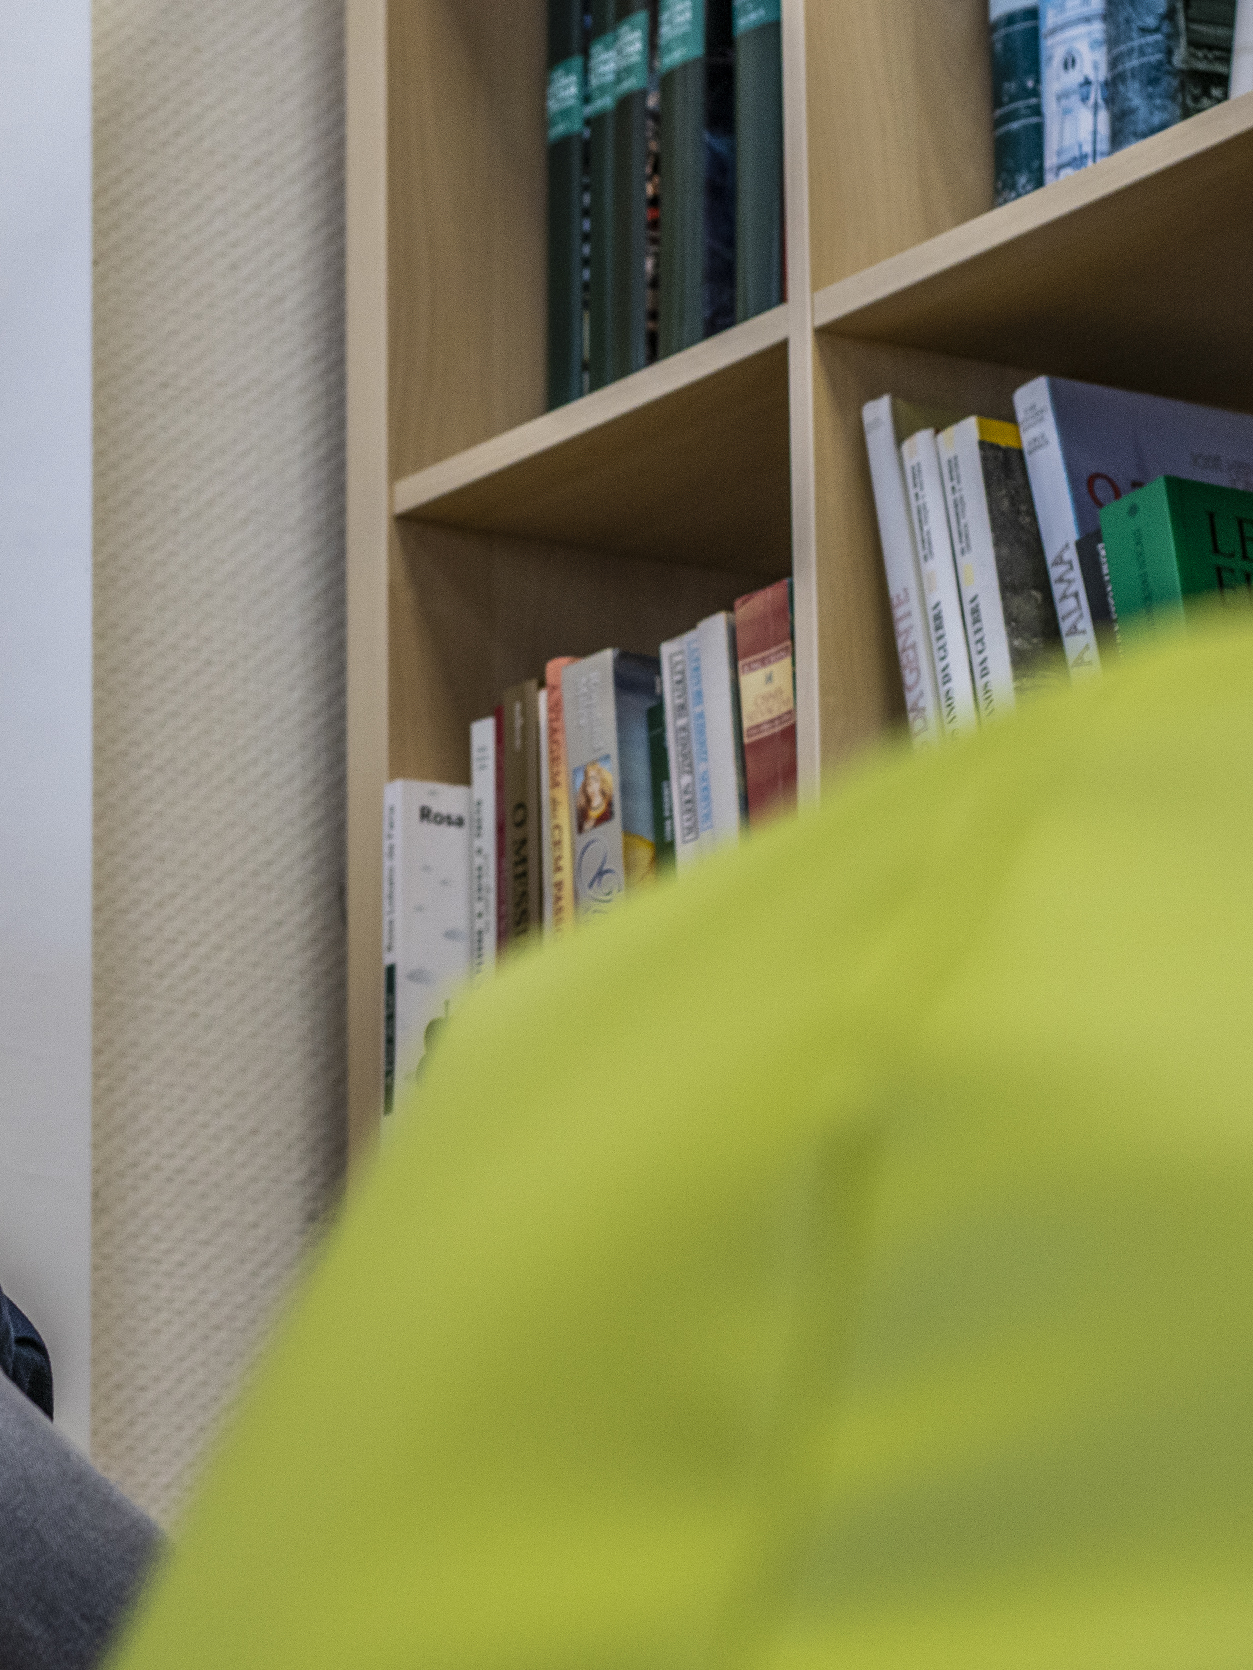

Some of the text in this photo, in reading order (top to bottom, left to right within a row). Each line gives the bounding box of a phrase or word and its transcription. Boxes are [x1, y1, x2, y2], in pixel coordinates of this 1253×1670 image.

[1047, 542, 1086, 638] ALMA
[889, 586, 922, 694] GENTE
[930, 599, 949, 662] GUERRA
[968, 593, 987, 655] GUERRA
[938, 663, 953, 686] DA
[977, 656, 990, 679] DA
[547, 697, 563, 788] VIAGEM
[419, 805, 465, 829] Rosa
[511, 801, 528, 828] O
[550, 823, 563, 873] CEM
[552, 878, 565, 928] PASS
